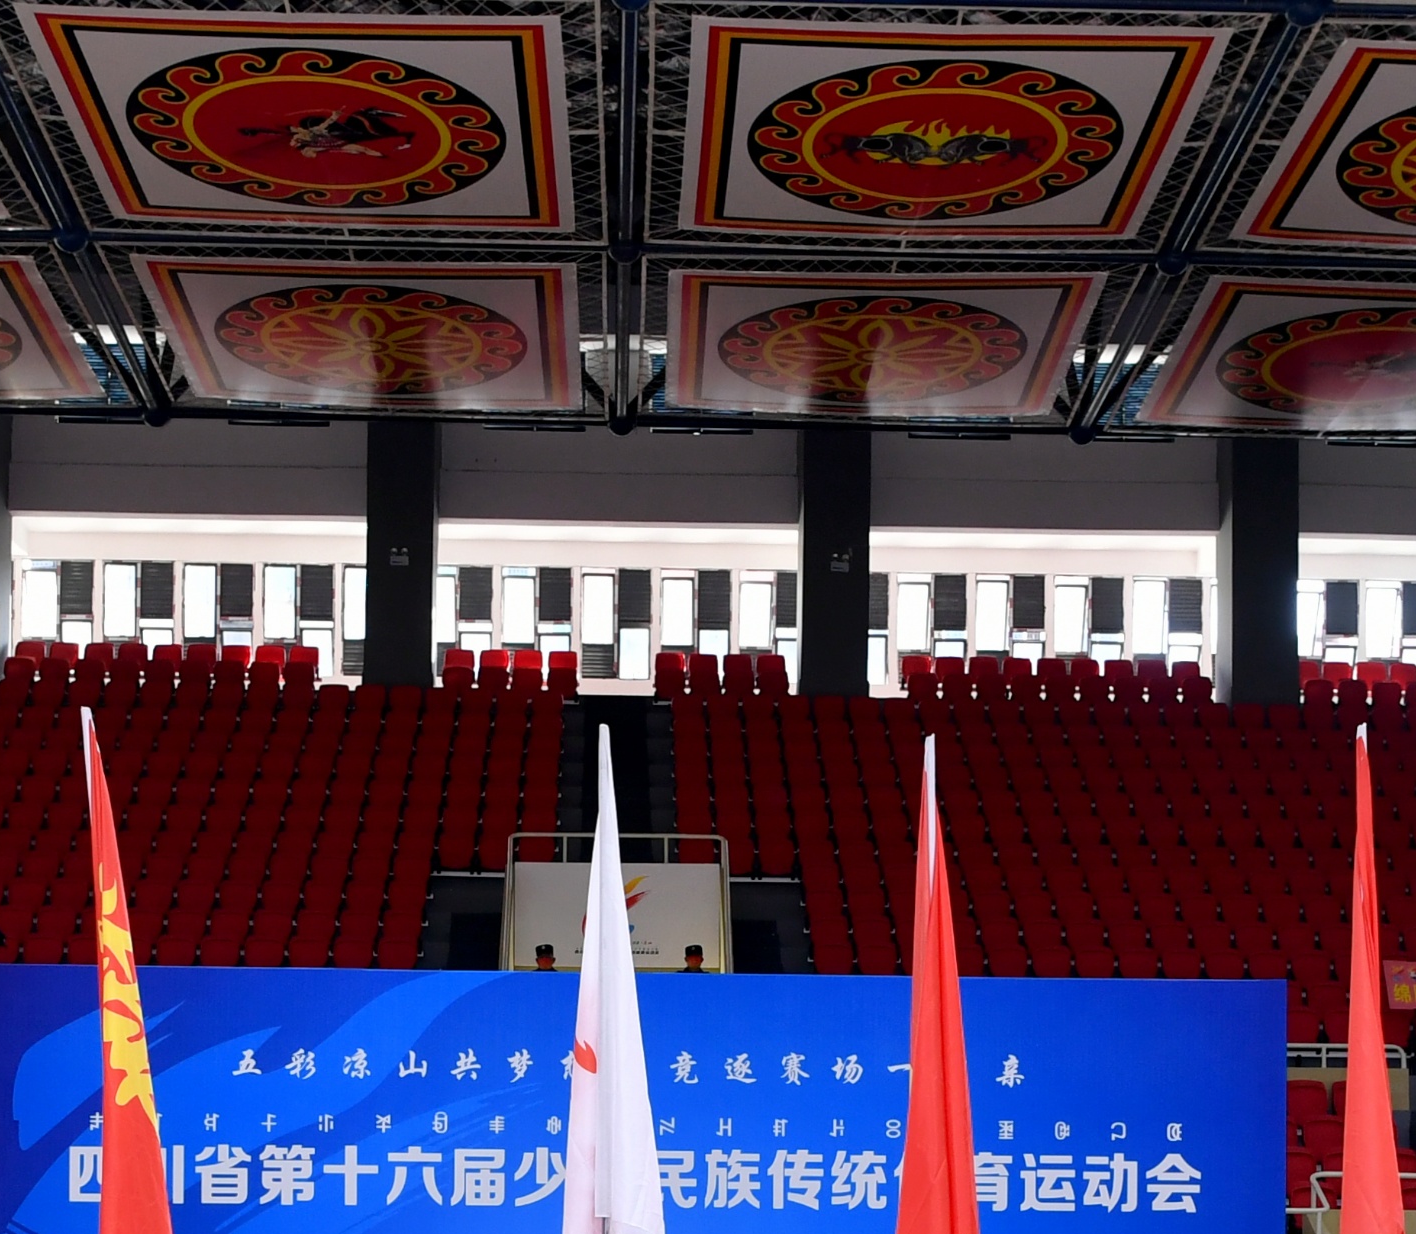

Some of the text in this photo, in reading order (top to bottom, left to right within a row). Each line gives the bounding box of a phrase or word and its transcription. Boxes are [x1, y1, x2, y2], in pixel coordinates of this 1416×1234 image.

[69, 1144, 1202, 1213] 四省第十六届少民族传统育运动会
